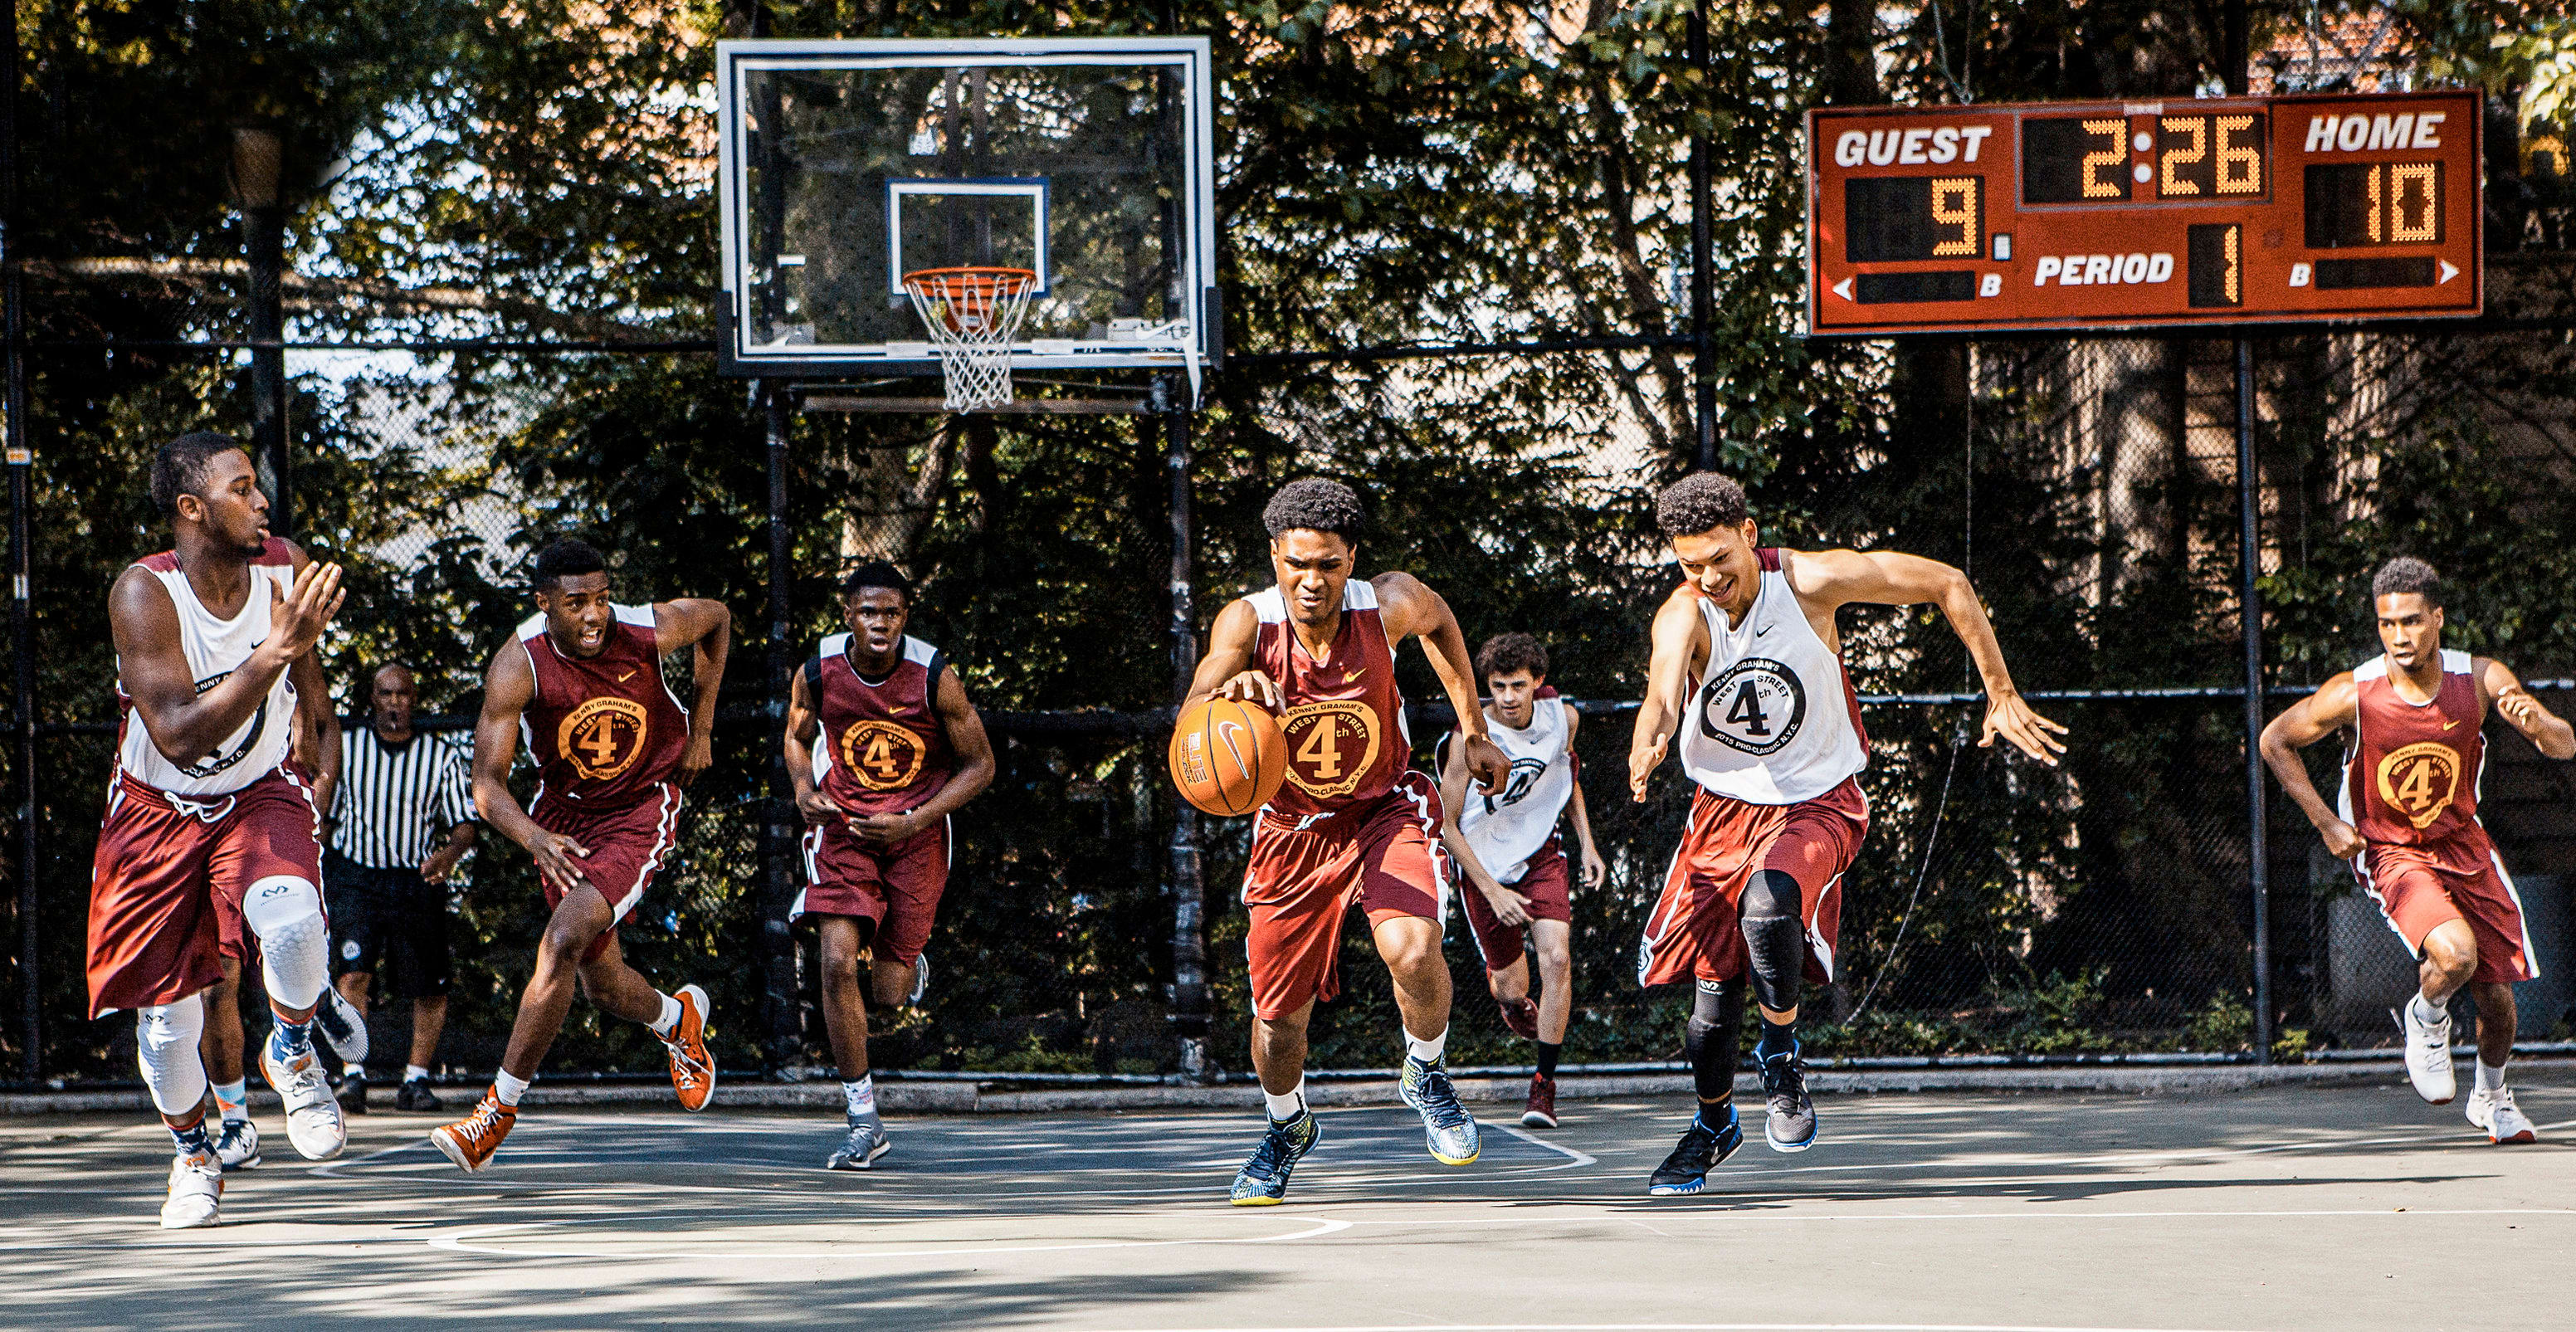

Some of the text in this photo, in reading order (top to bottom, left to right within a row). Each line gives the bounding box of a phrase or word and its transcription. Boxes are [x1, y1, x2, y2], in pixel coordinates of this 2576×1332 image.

[2304, 113, 2447, 153] HOME
[1835, 126, 1992, 168] GUEST
[2082, 115, 2261, 198] 2:26
[2368, 163, 2437, 243] 10
[1931, 177, 1977, 256] 9
[2035, 254, 2174, 286] PERIOD
[2224, 226, 2239, 302] 1
[2289, 264, 2310, 287] B
[1980, 274, 2003, 298] B
[1736, 660, 1780, 672] GRAHAM'S
[195, 676, 221, 693] ENNY
[1712, 681, 1737, 706] WEST
[1757, 675, 1789, 699] STREET
[597, 700, 638, 712] GRAHAM'S
[1287, 703, 1364, 717] KENNY GRAHAM'S
[575, 715, 598, 736] WEST
[1288, 715, 1317, 735] WEST
[1337, 713, 1367, 739] STREET
[1715, 733, 1734, 745] 2015
